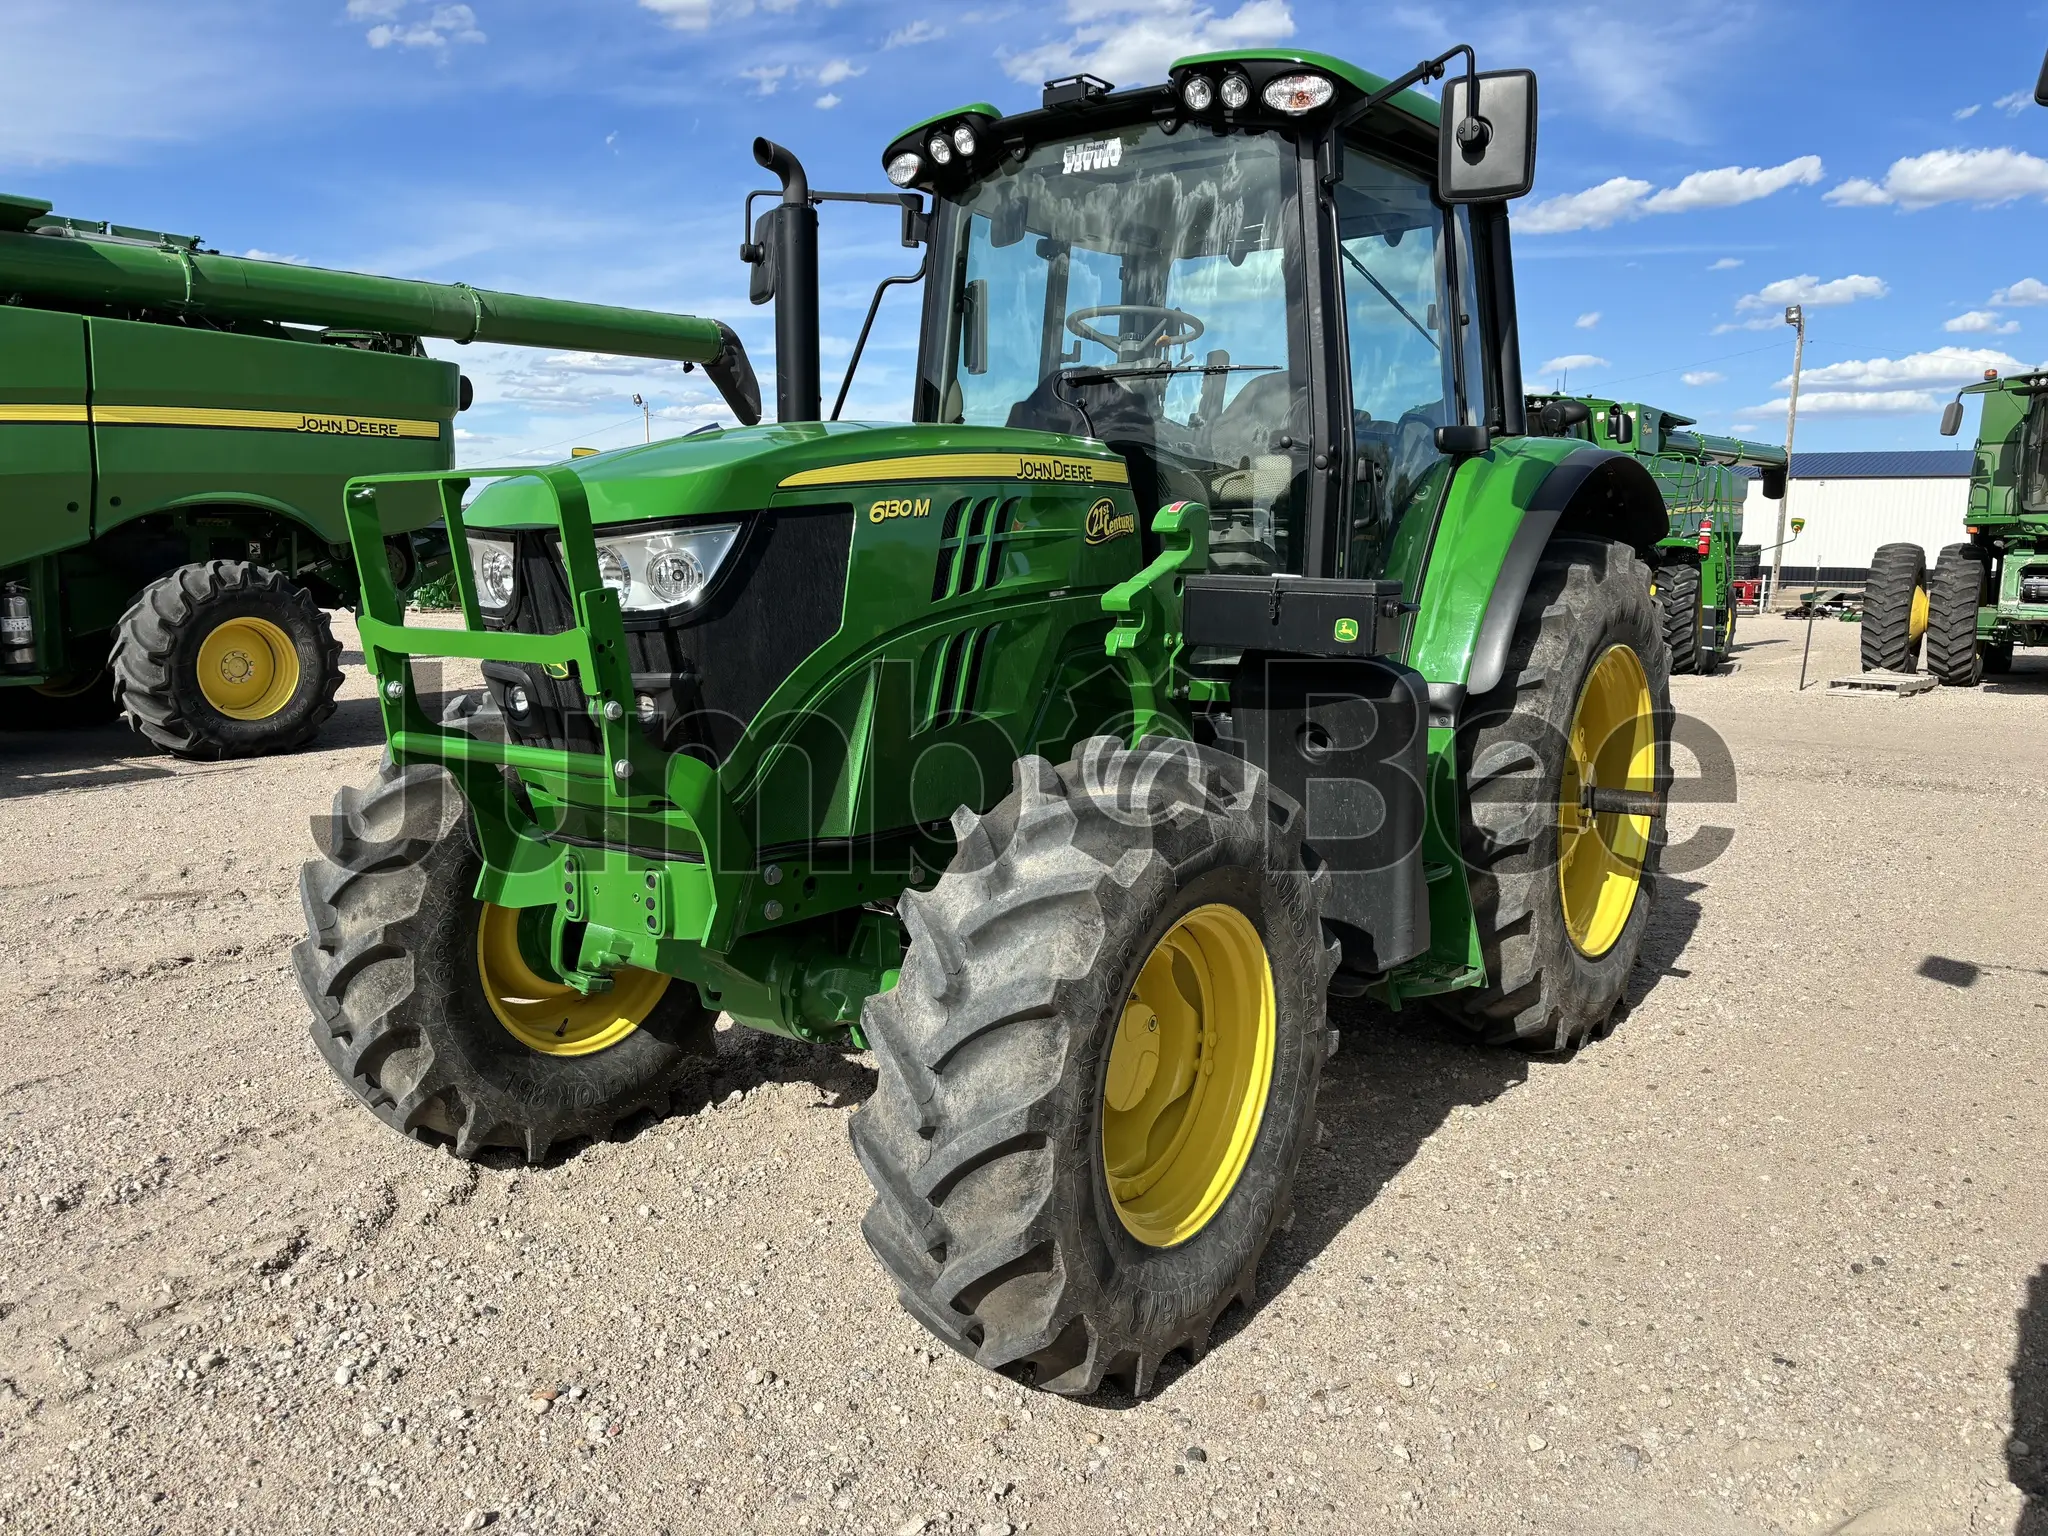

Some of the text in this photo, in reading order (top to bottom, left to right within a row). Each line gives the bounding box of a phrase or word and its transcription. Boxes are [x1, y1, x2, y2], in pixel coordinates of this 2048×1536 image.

[297, 415, 398, 435] JOHN DEERE
[1016, 458, 1093, 480] JOHN DEERE
[869, 498, 931, 524] 6130 M
